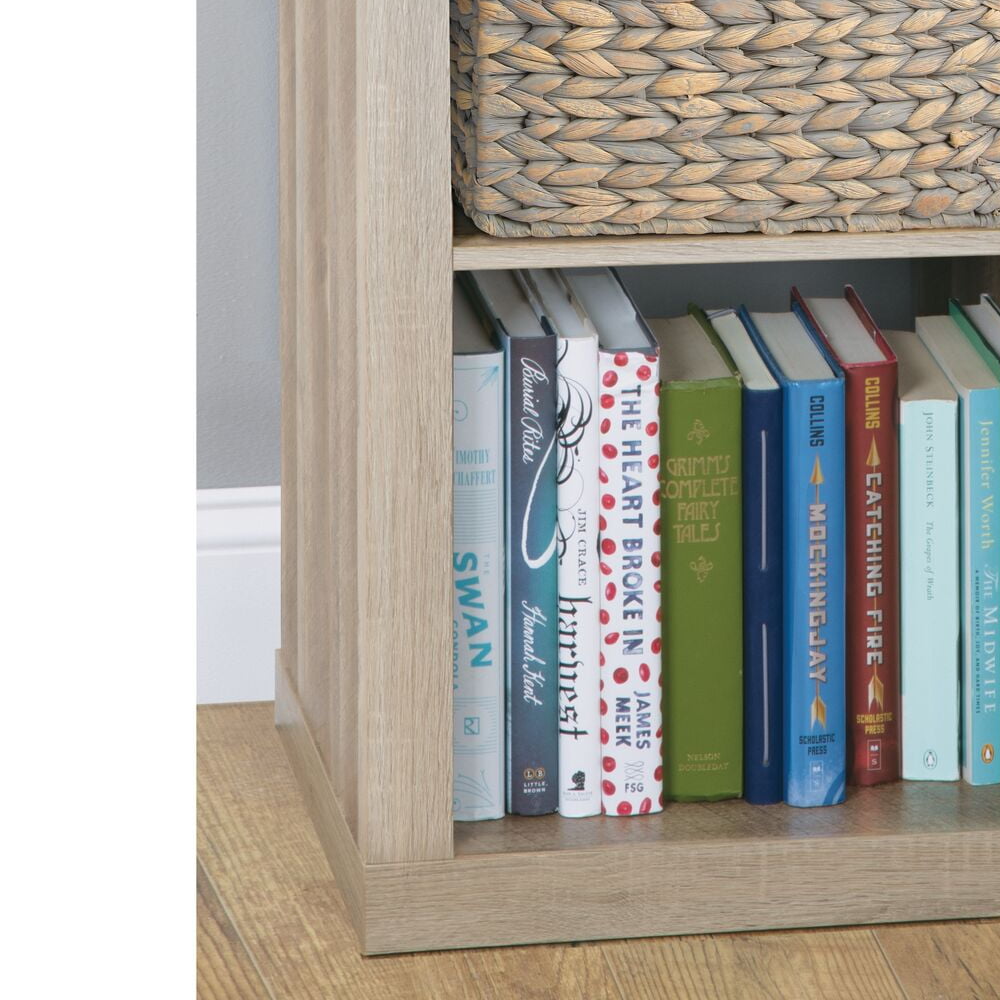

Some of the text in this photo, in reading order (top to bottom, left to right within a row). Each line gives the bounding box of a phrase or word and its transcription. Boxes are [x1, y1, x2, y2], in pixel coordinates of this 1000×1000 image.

[520, 357, 550, 464] Burial Rites
[809, 395, 825, 447] COLLINS
[864, 376, 881, 430] COLLINS
[666, 455, 732, 477] GRIMM'S
[979, 420, 997, 550] Jennifer Worth
[621, 385, 644, 656] THE HEART BROKE IN
[672, 522, 721, 544] TALES
[677, 500, 720, 521] FAIRY
[922, 411, 936, 601] JOHN STEINBECK The Grapes of Wrath
[577, 508, 587, 586] JIM CRACE
[865, 472, 883, 666] CATCHING FIRE
[453, 551, 493, 668] SWAN
[808, 503, 828, 682] MOCKINGJAY
[521, 600, 547, 706] Hannah Kent
[559, 596, 593, 741] harvest
[983, 606, 999, 714] MIDWIFE
[615, 697, 632, 747] MEEK
[633, 691, 652, 749] JAMES
[798, 733, 836, 745] SCHOLASTIC
[856, 711, 894, 724] SCHOLASTIC
[865, 723, 885, 735] PRESS
[807, 745, 828, 756] PRESS
[624, 782, 645, 793] FSG
